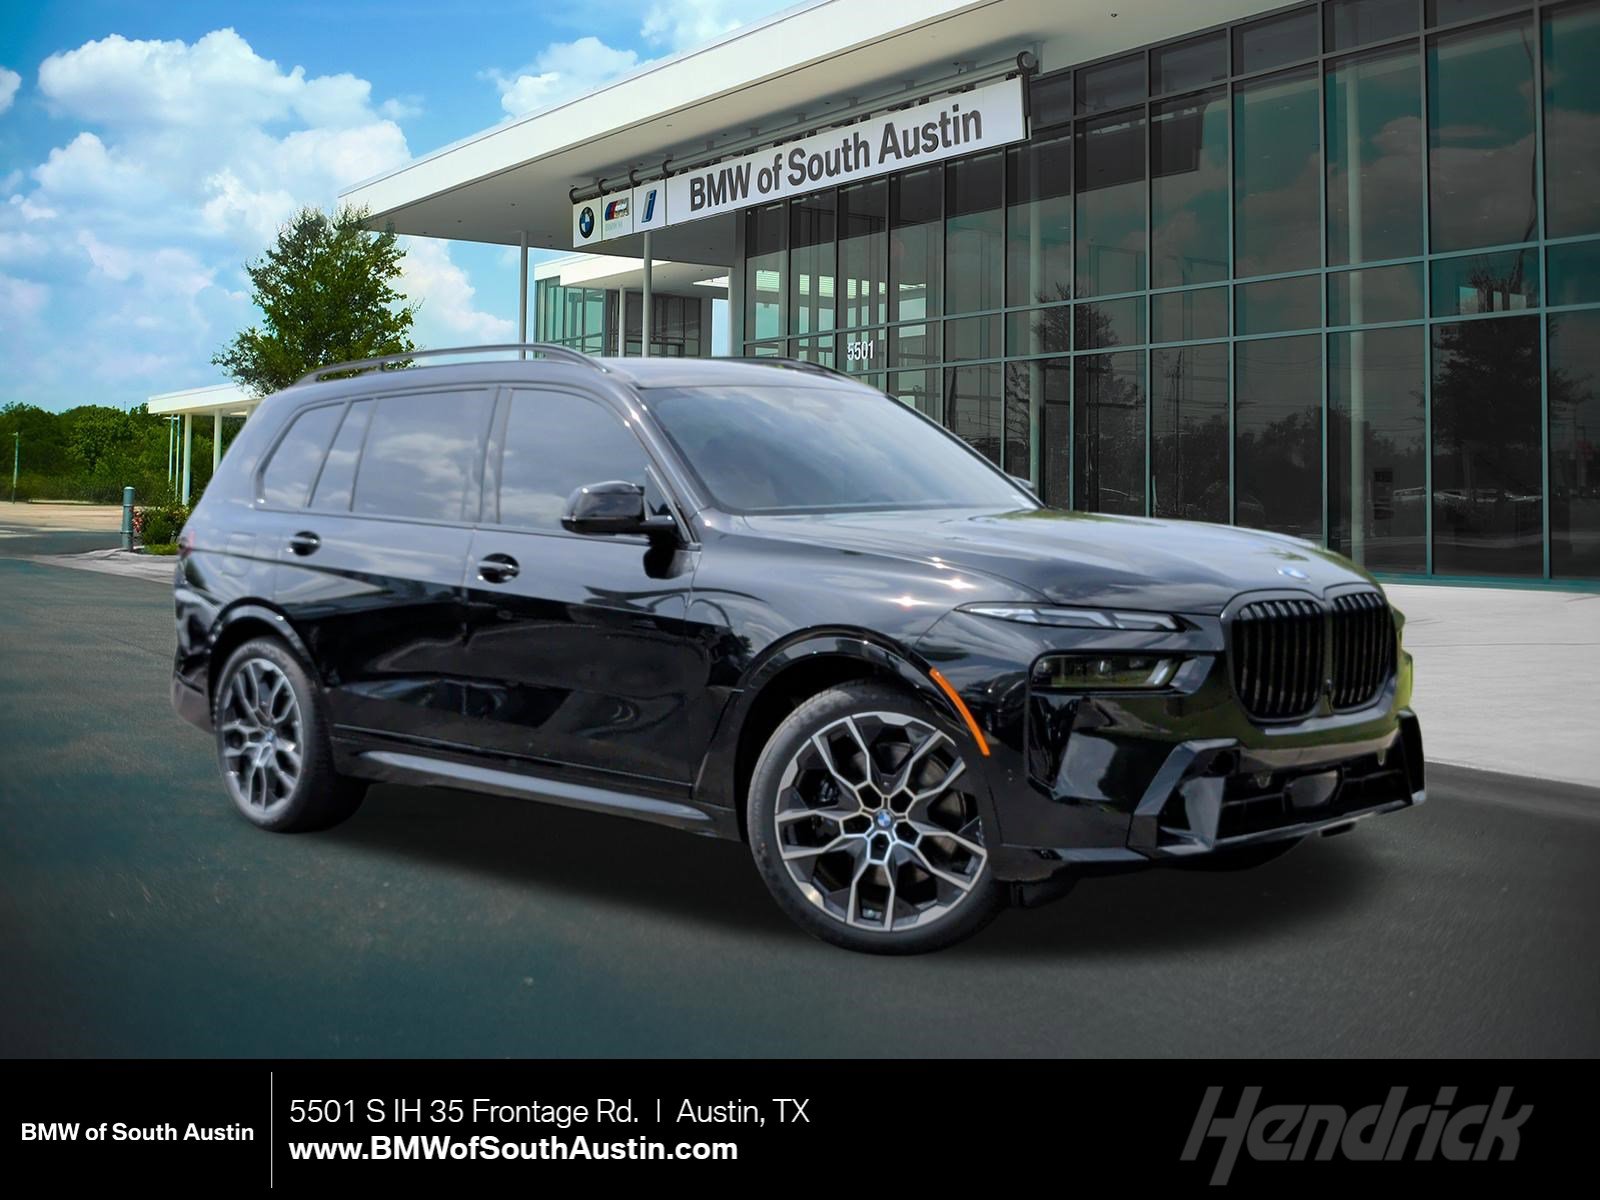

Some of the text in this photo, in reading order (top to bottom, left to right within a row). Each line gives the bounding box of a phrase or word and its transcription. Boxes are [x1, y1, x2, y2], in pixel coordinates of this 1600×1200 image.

[690, 161, 752, 212] BMW
[757, 153, 783, 194] of
[787, 131, 871, 186] South
[877, 103, 982, 164] Austin
[847, 340, 874, 361] 5501
